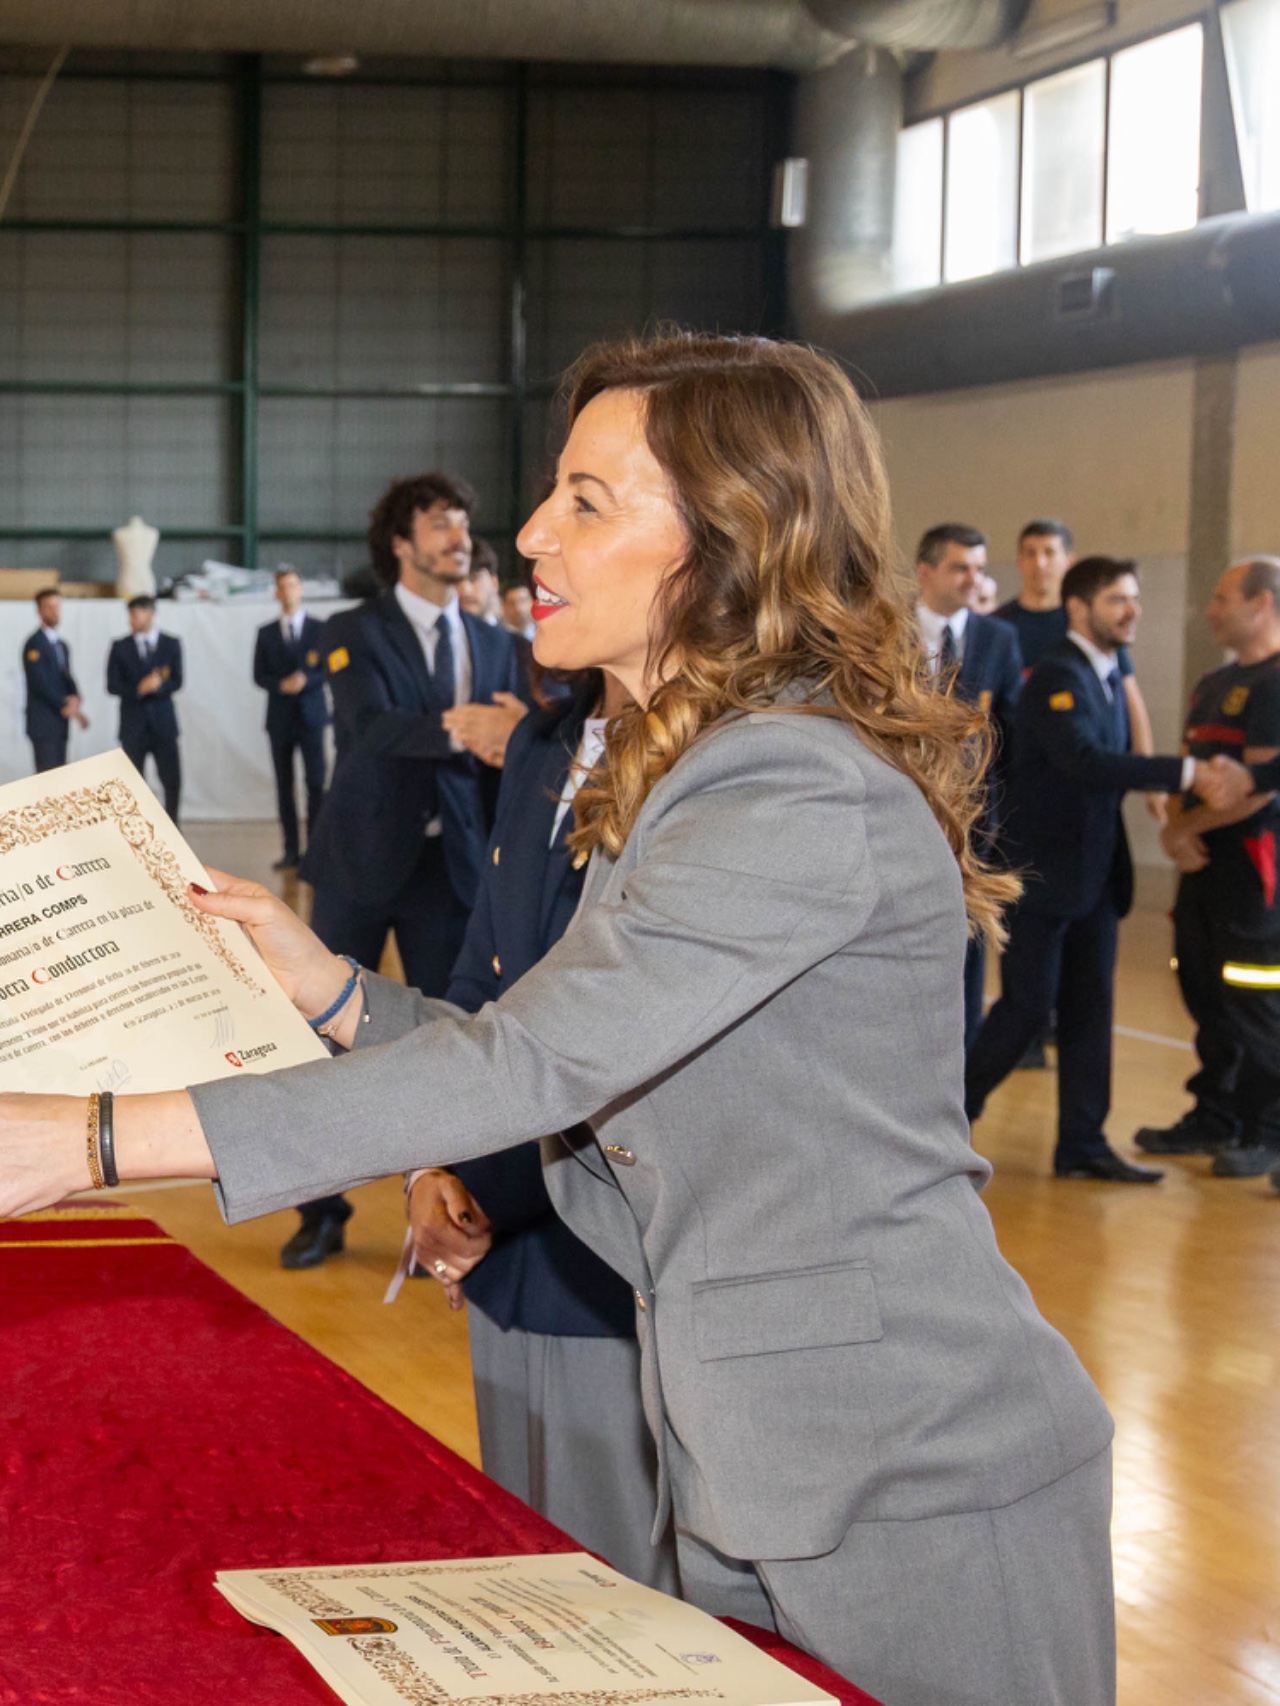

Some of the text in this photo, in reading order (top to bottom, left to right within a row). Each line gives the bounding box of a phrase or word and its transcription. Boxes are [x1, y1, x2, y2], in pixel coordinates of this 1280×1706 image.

[35, 874, 56, 890] de
[55, 857, 111, 881] Carrera
[41, 894, 88, 919] COMPS
[31, 940, 120, 985] Conductora
